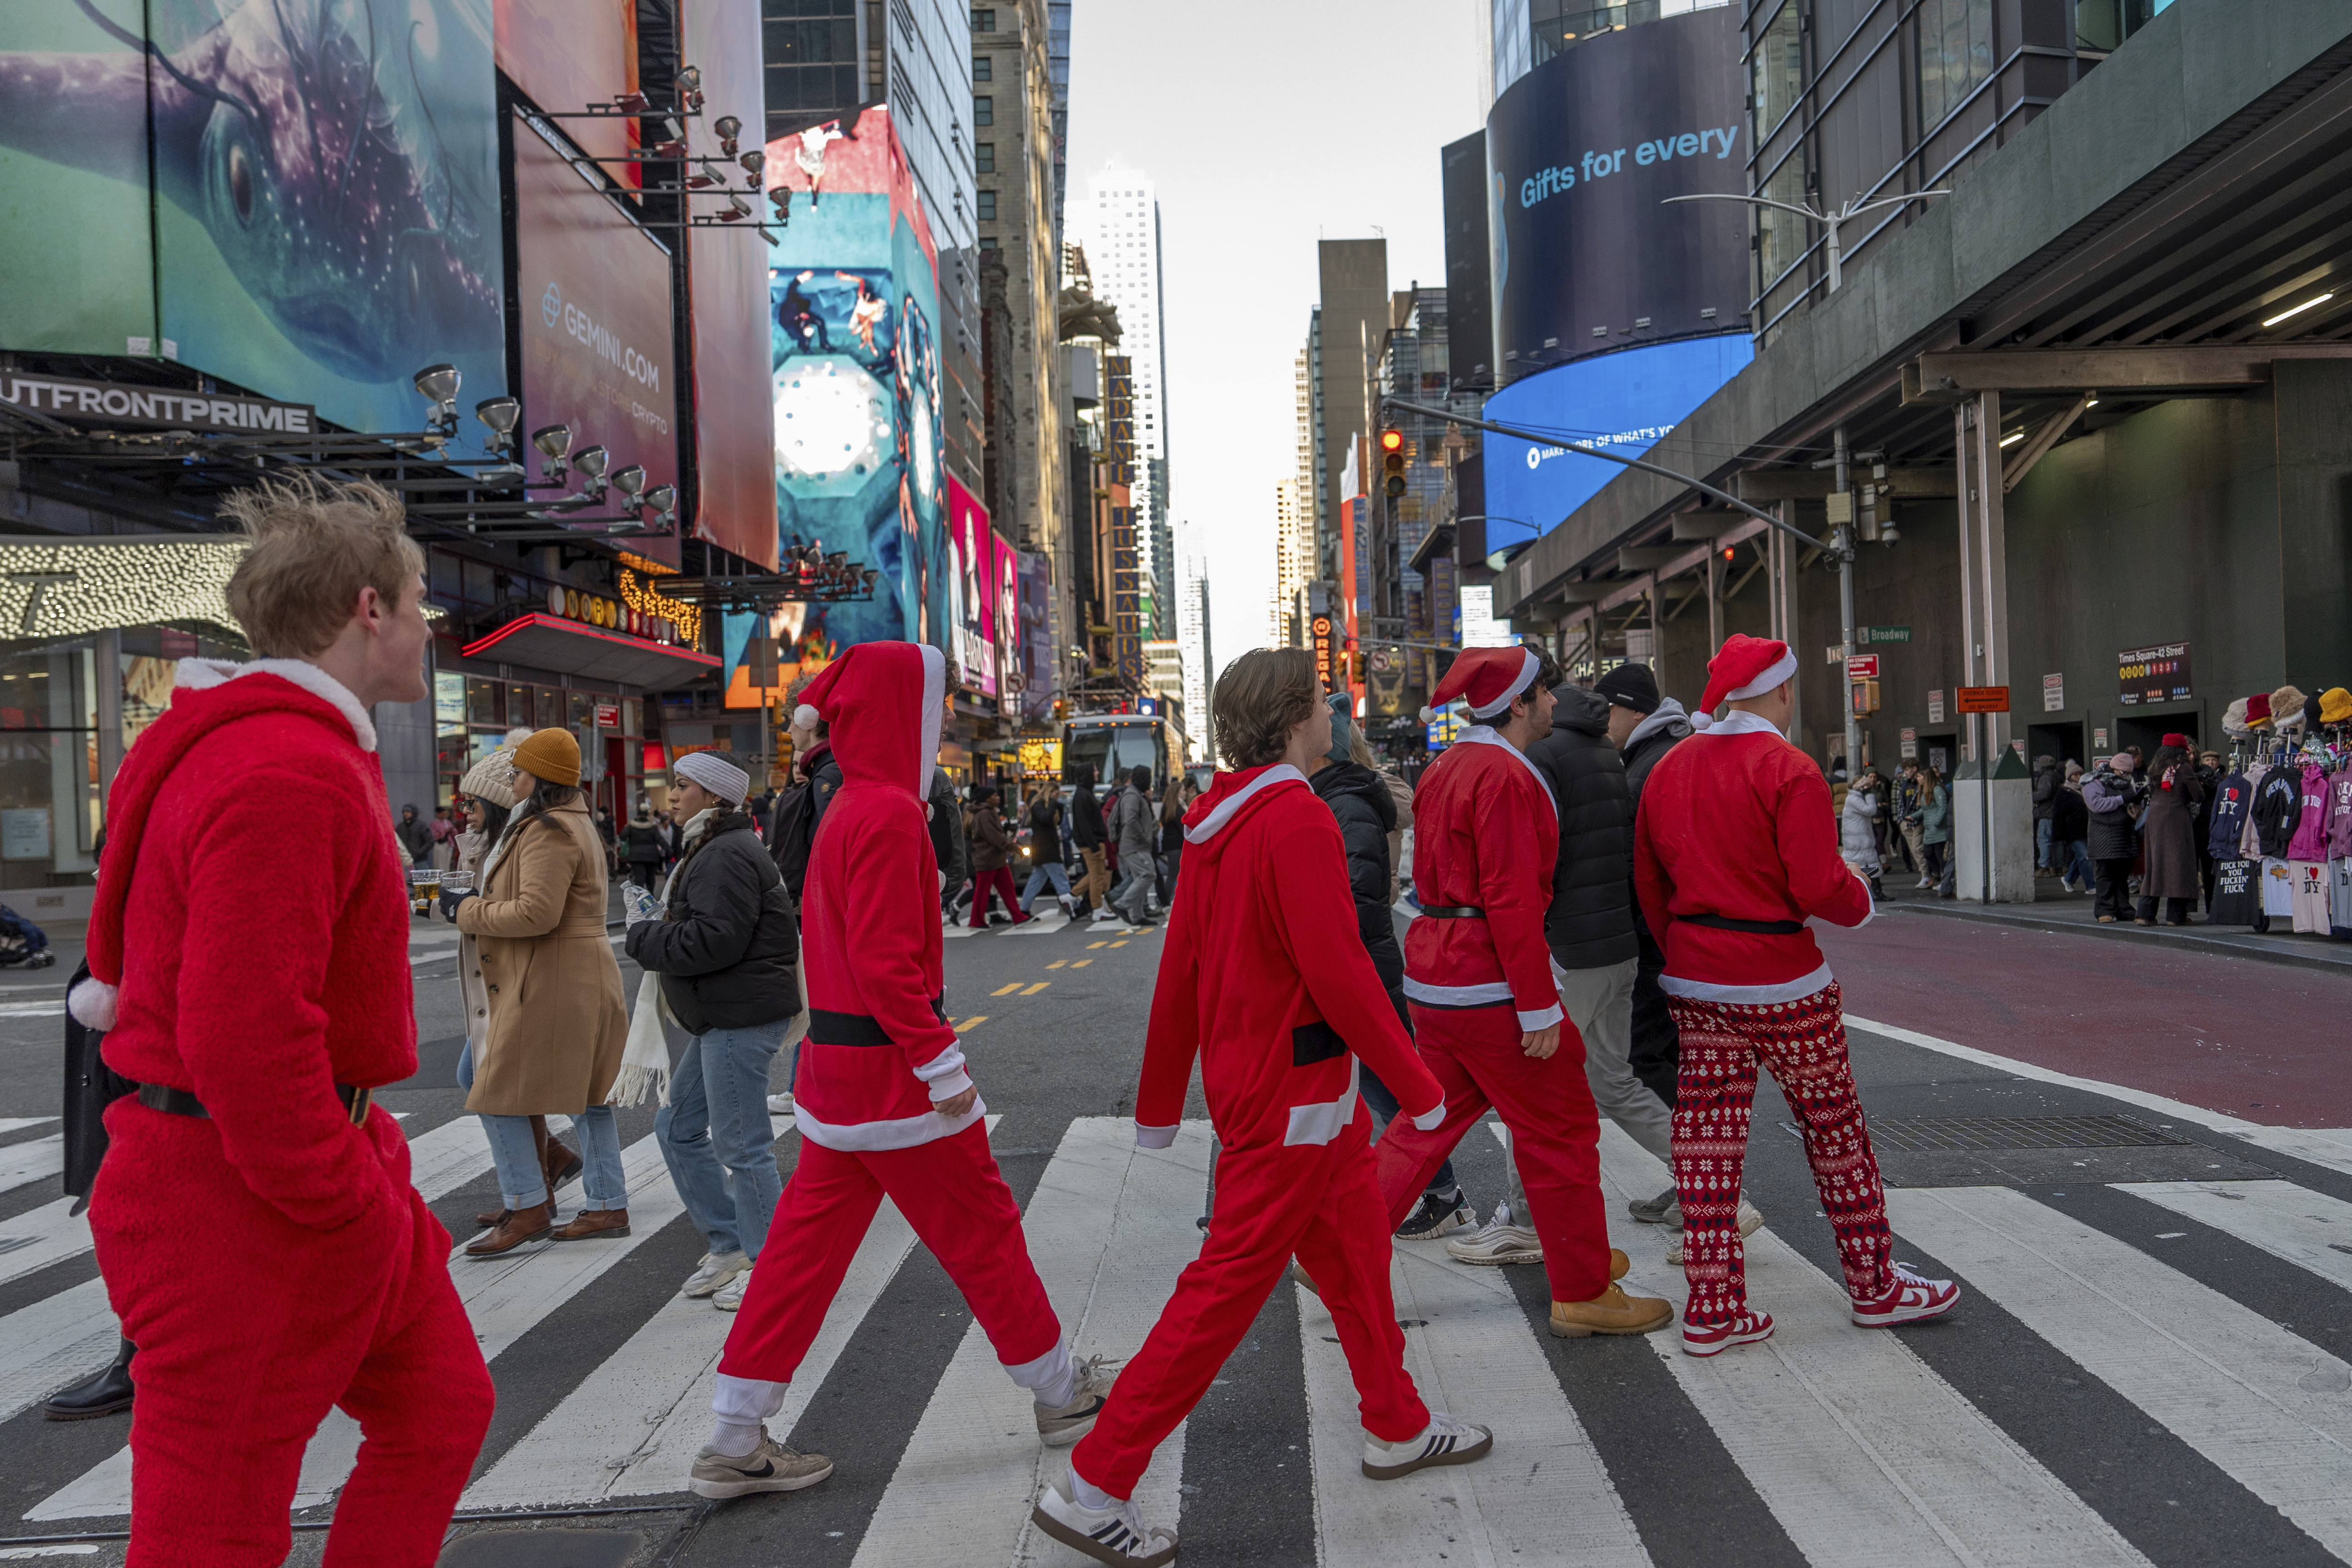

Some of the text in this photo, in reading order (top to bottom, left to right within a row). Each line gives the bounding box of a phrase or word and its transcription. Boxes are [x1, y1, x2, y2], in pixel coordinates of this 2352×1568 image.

[1521, 125, 1739, 208] Gifts for every
[565, 302, 659, 393] GEMINI.COM
[632, 401, 668, 435] CRYPTO
[1541, 446, 1565, 460] MAKE
[1596, 436, 1611, 447] OF
[1612, 427, 1656, 444] WHAT'S
[1110, 357, 1138, 676] MADAME TUSSAUDS
[1871, 628, 1909, 642] Broadway
[2119, 646, 2184, 663] Times Square-42 Street
[1316, 638, 1331, 692] REGA
[2223, 787, 2230, 801] I
[2266, 777, 2281, 798] NEW
[2218, 801, 2238, 815] NY
[2220, 860, 2250, 870] FUCK YOU
[2228, 868, 2243, 877] YOU
[2304, 867, 2309, 879] I
[2224, 884, 2245, 894] FUCK
[2303, 881, 2321, 894] NY
